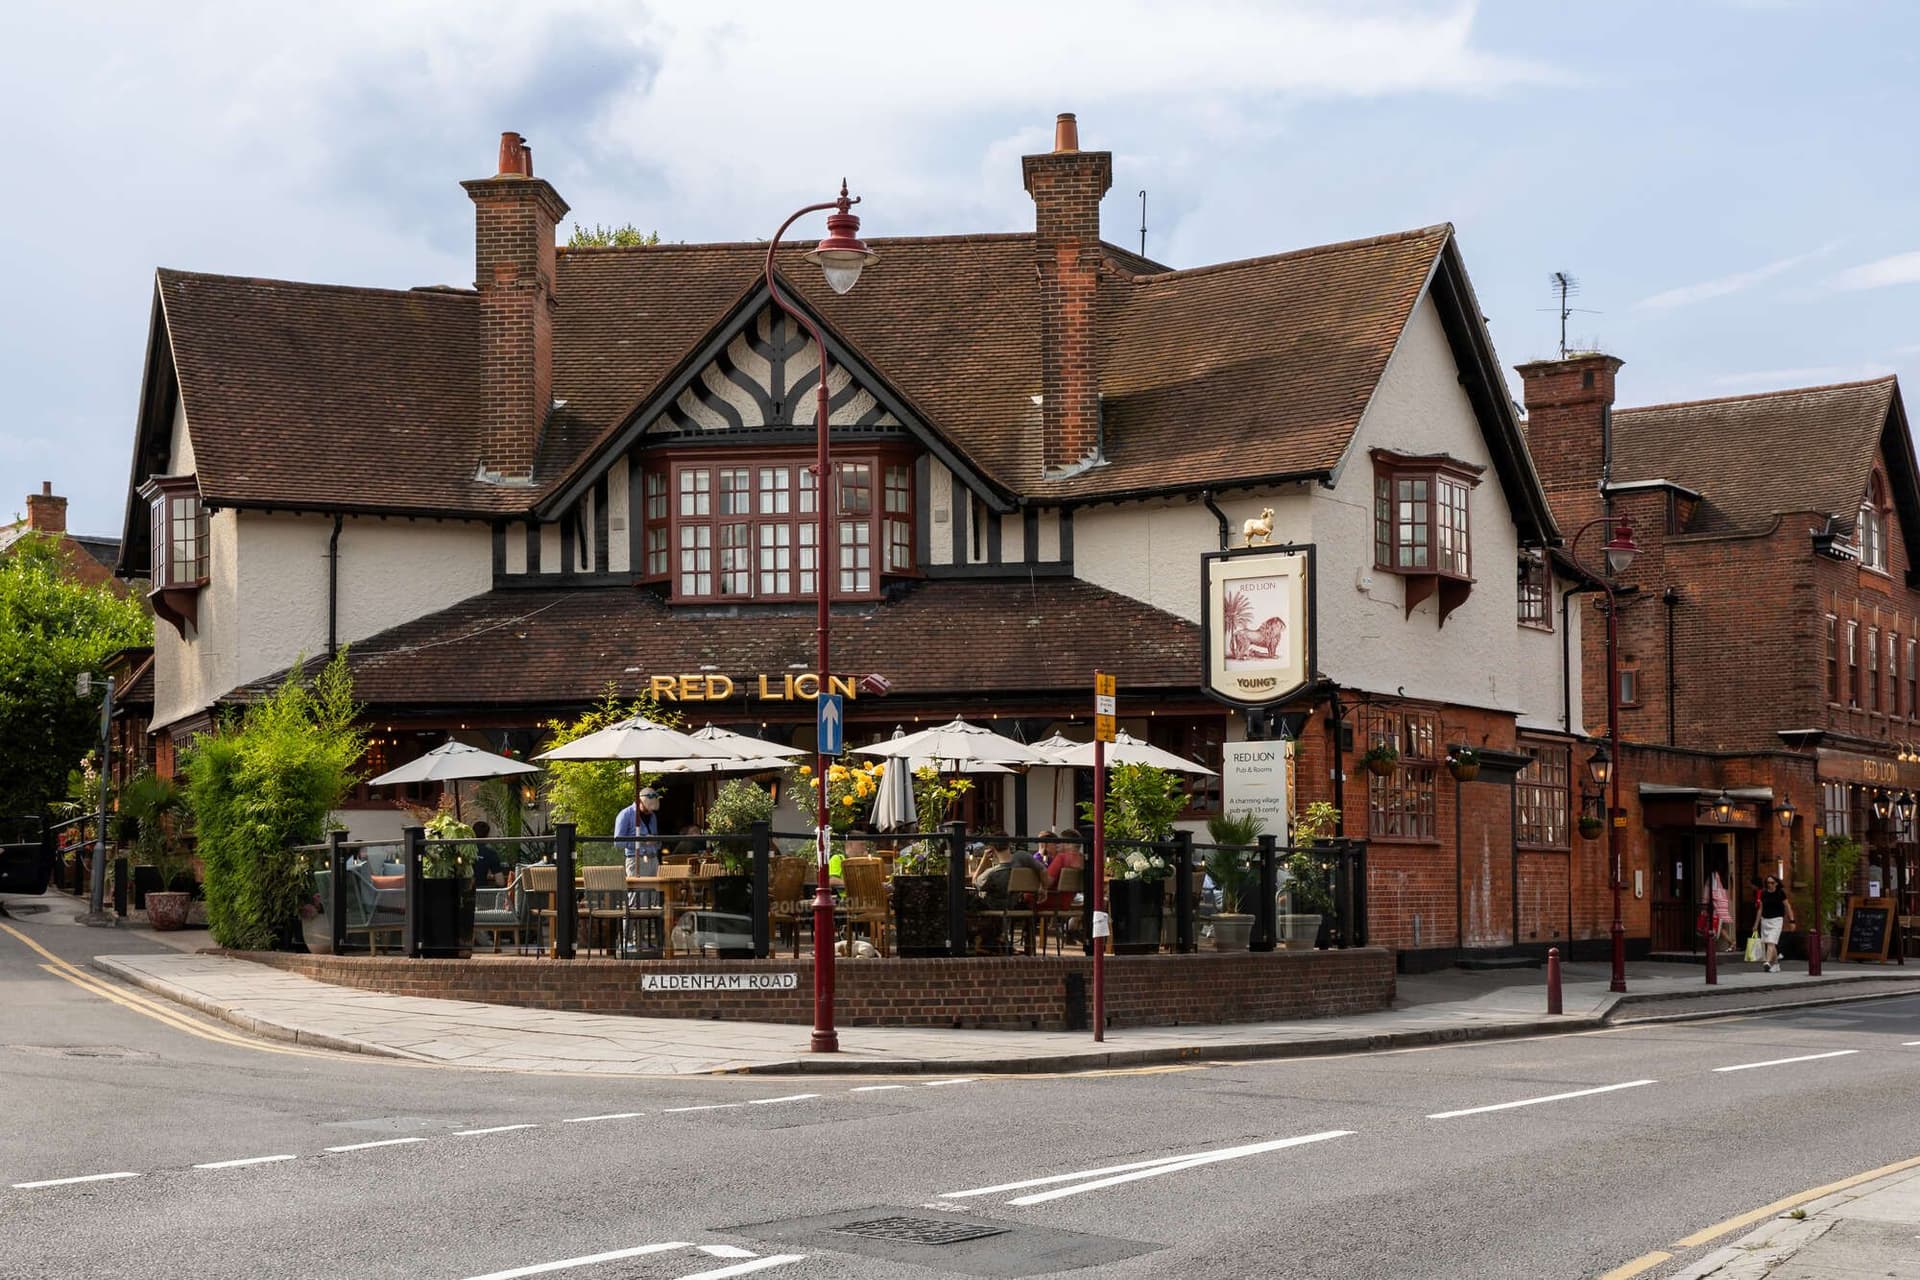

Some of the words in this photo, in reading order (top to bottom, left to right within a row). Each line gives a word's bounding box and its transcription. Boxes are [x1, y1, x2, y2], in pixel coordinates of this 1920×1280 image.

[1240, 584, 1255, 592] RED
[1256, 582, 1276, 591] LION
[650, 674, 734, 702] RED
[758, 673, 856, 701] LION
[1237, 678, 1276, 689] YOUNG'S
[1233, 753, 1252, 762] RED
[1253, 752, 1275, 761] LION
[1863, 759, 1878, 780] RED
[1879, 761, 1899, 783] LION
[1262, 806, 1279, 814] comfy
[648, 975, 741, 989] ALDENHAM
[749, 974, 794, 988] ROAD
